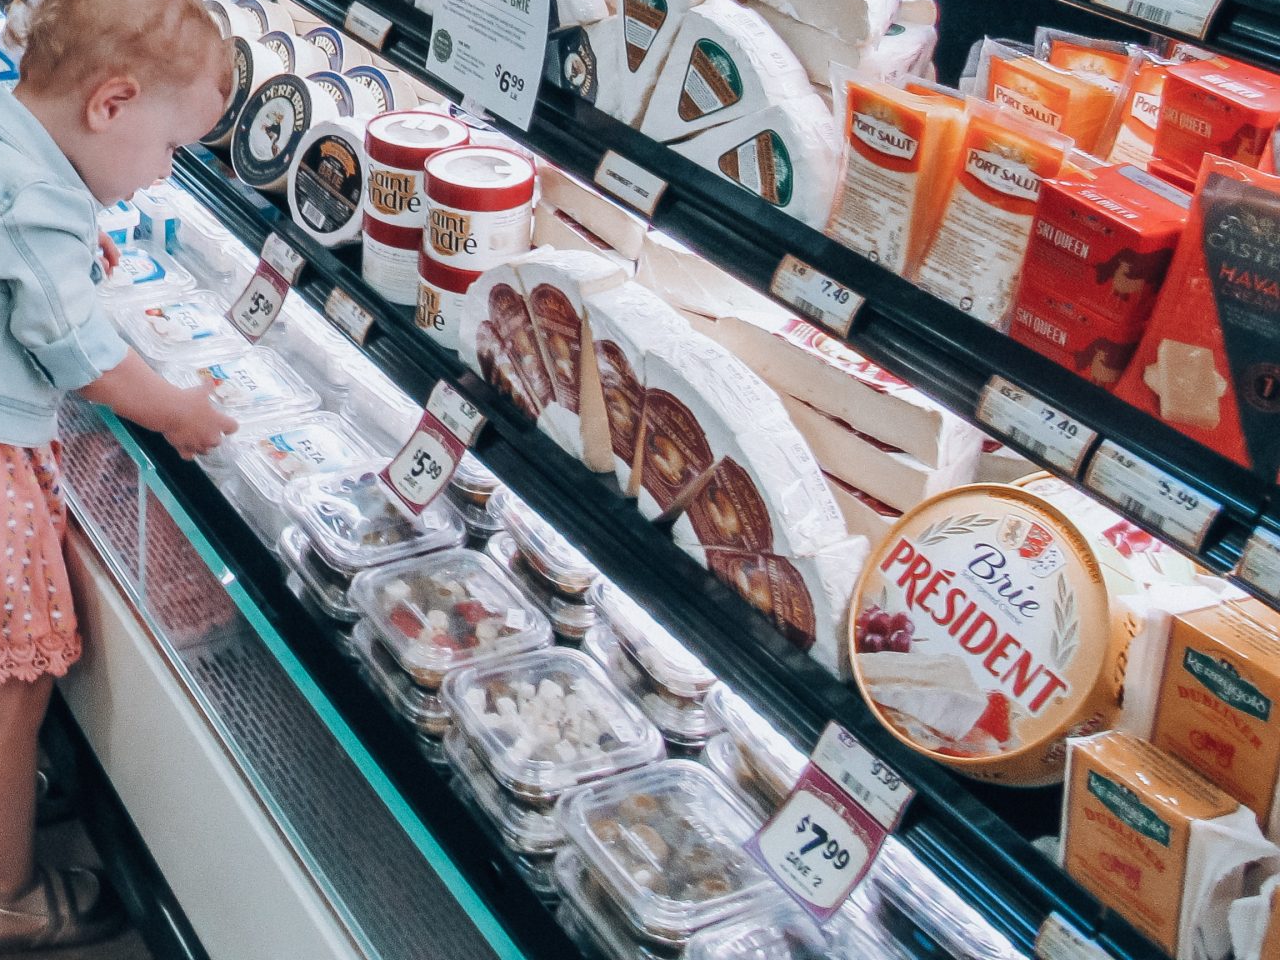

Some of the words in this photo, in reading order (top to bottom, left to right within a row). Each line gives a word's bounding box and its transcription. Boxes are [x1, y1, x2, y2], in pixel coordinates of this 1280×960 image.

[995, 89, 1021, 110] PORT
[1022, 106, 1059, 127] SALUT
[852, 113, 875, 137] PORT
[877, 130, 914, 151] SALUT
[969, 149, 1000, 176] PORT
[1002, 168, 1041, 193] SALUT
[1036, 221, 1053, 239] SKI
[1053, 227, 1090, 259] QUEEN
[1016, 307, 1032, 326] SKI
[1032, 314, 1067, 346] QUEEN
[967, 543, 1040, 618] Brie
[880, 538, 1067, 713] PRÉSIDENT
[785, 851, 812, 878] SAVE
